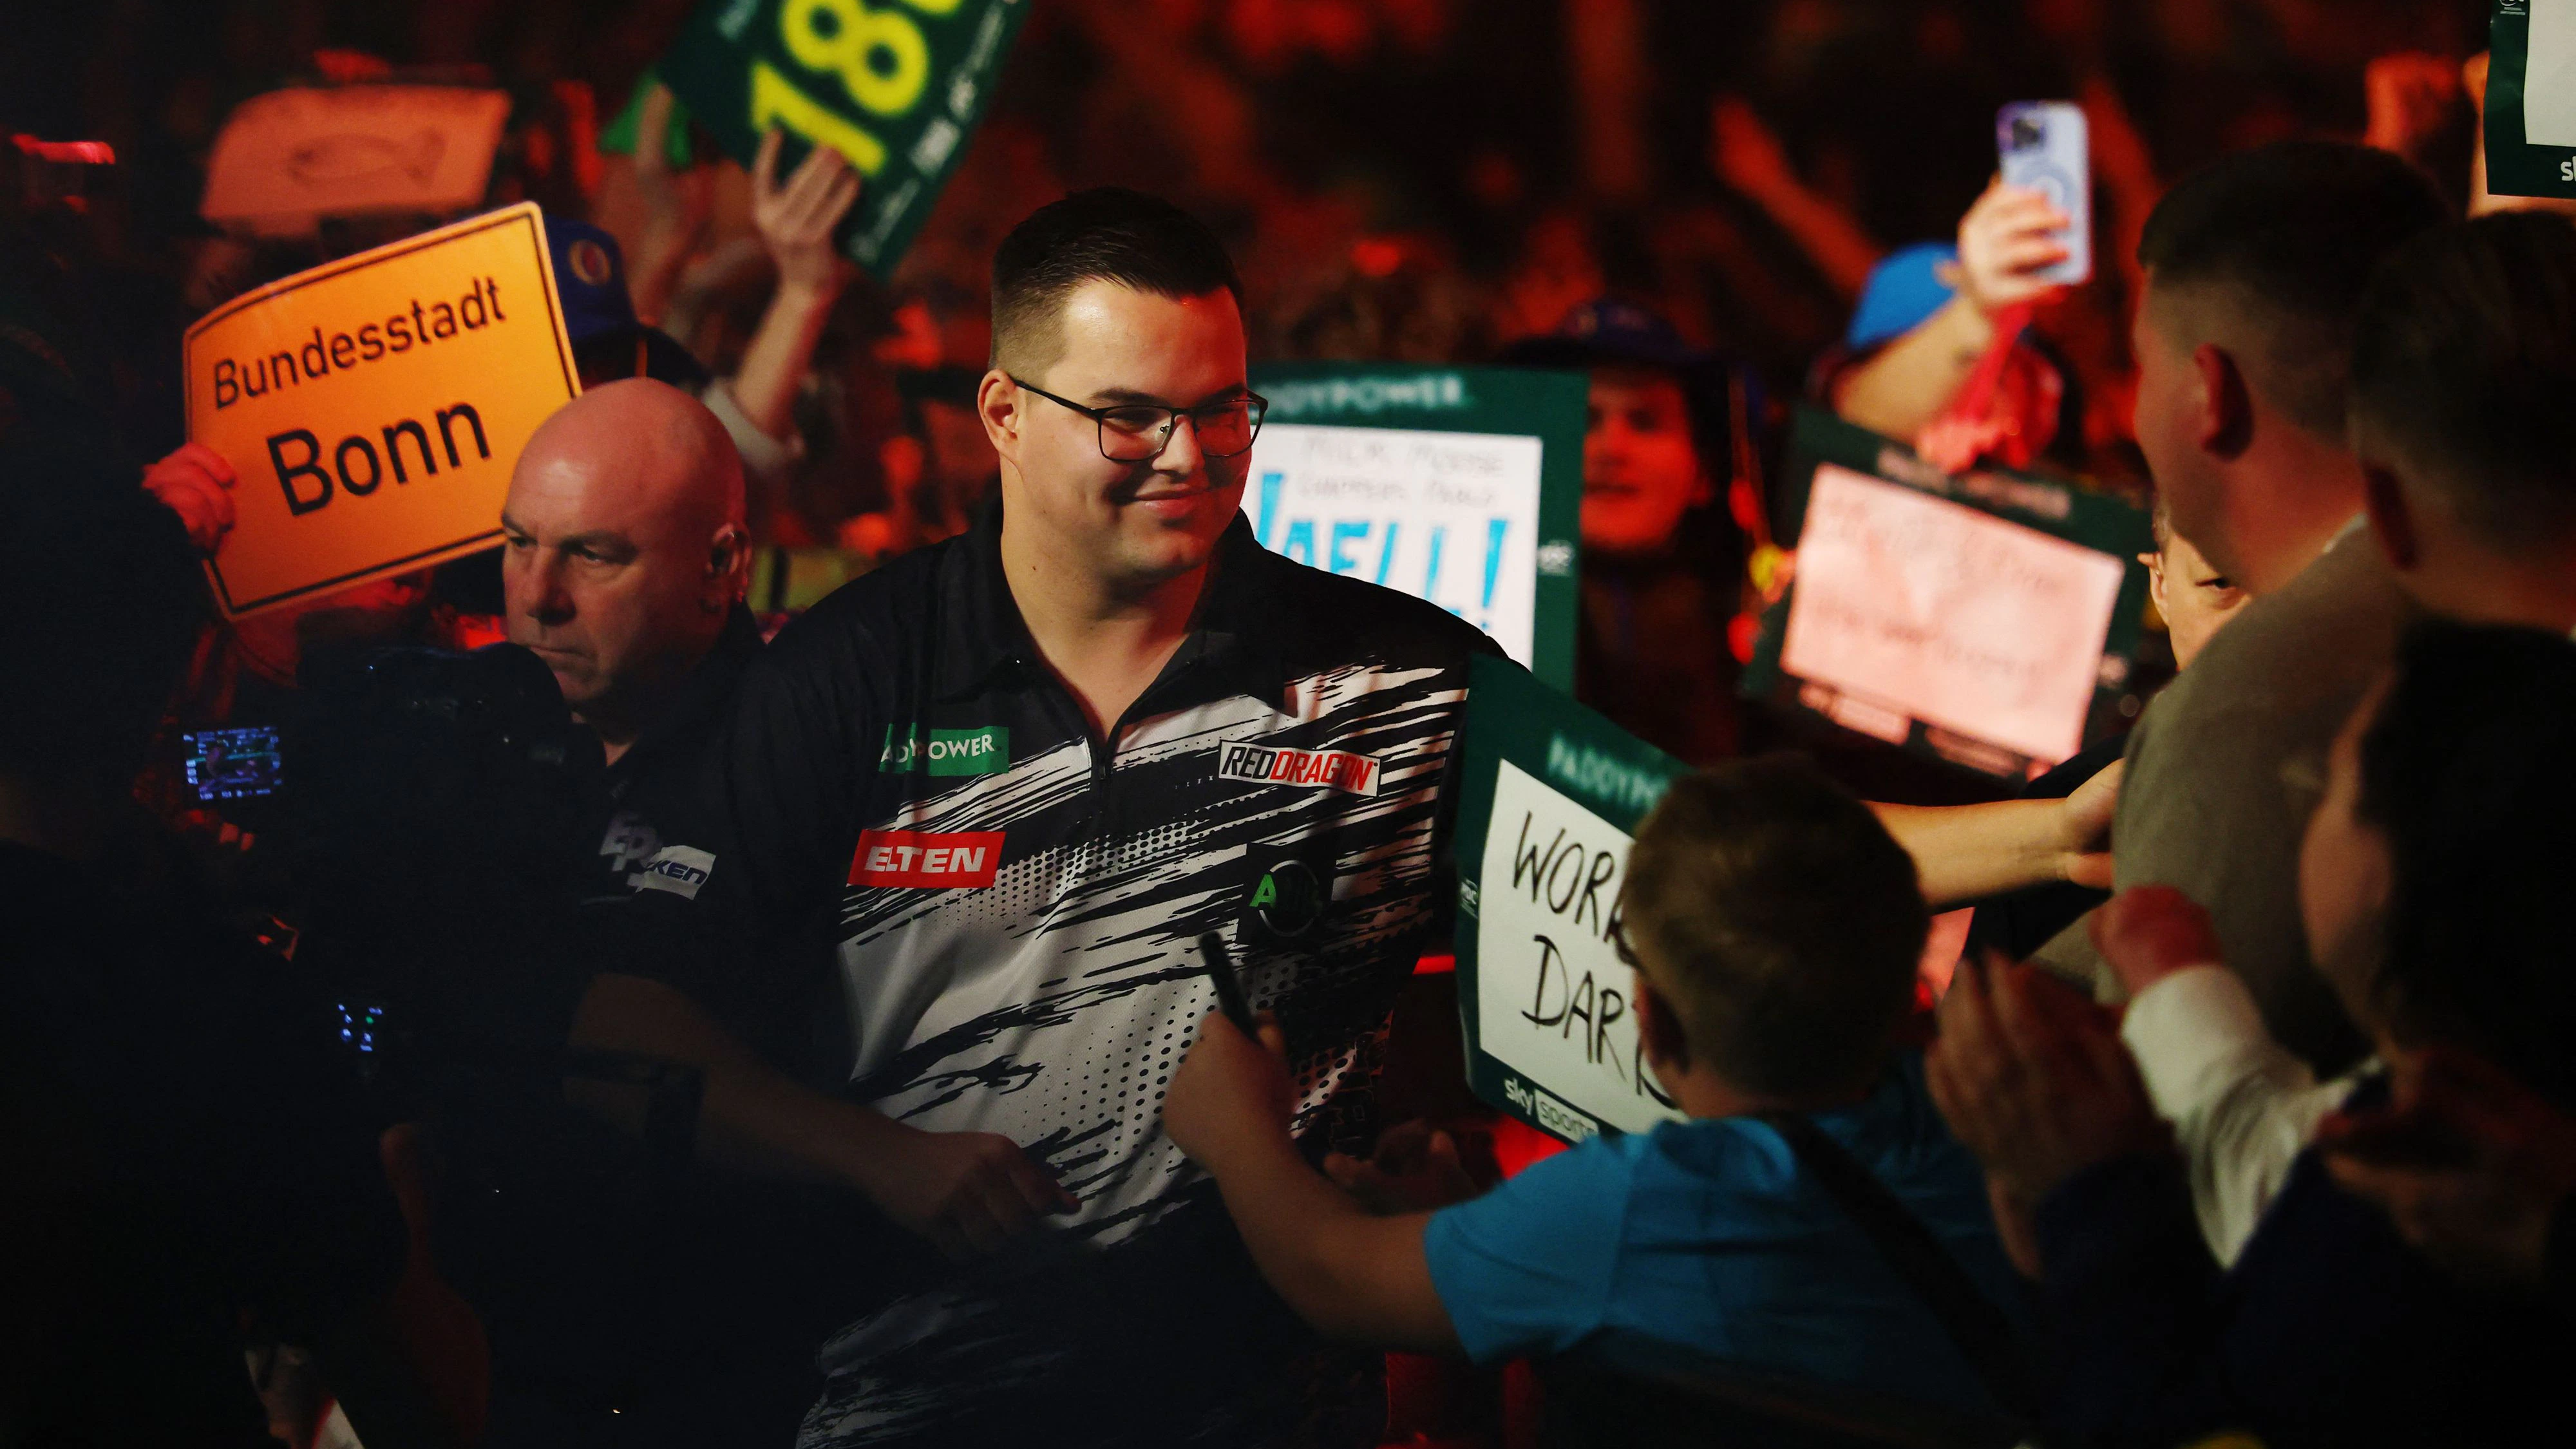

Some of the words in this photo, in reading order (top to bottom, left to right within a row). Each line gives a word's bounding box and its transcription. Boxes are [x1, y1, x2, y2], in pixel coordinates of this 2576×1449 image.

[750, 0, 963, 177] 18
[214, 276, 507, 410] Bundesstadt
[266, 401, 491, 517] Bonn
[864, 846, 987, 873] ELTEN
[1504, 1077, 1534, 1116] sky
